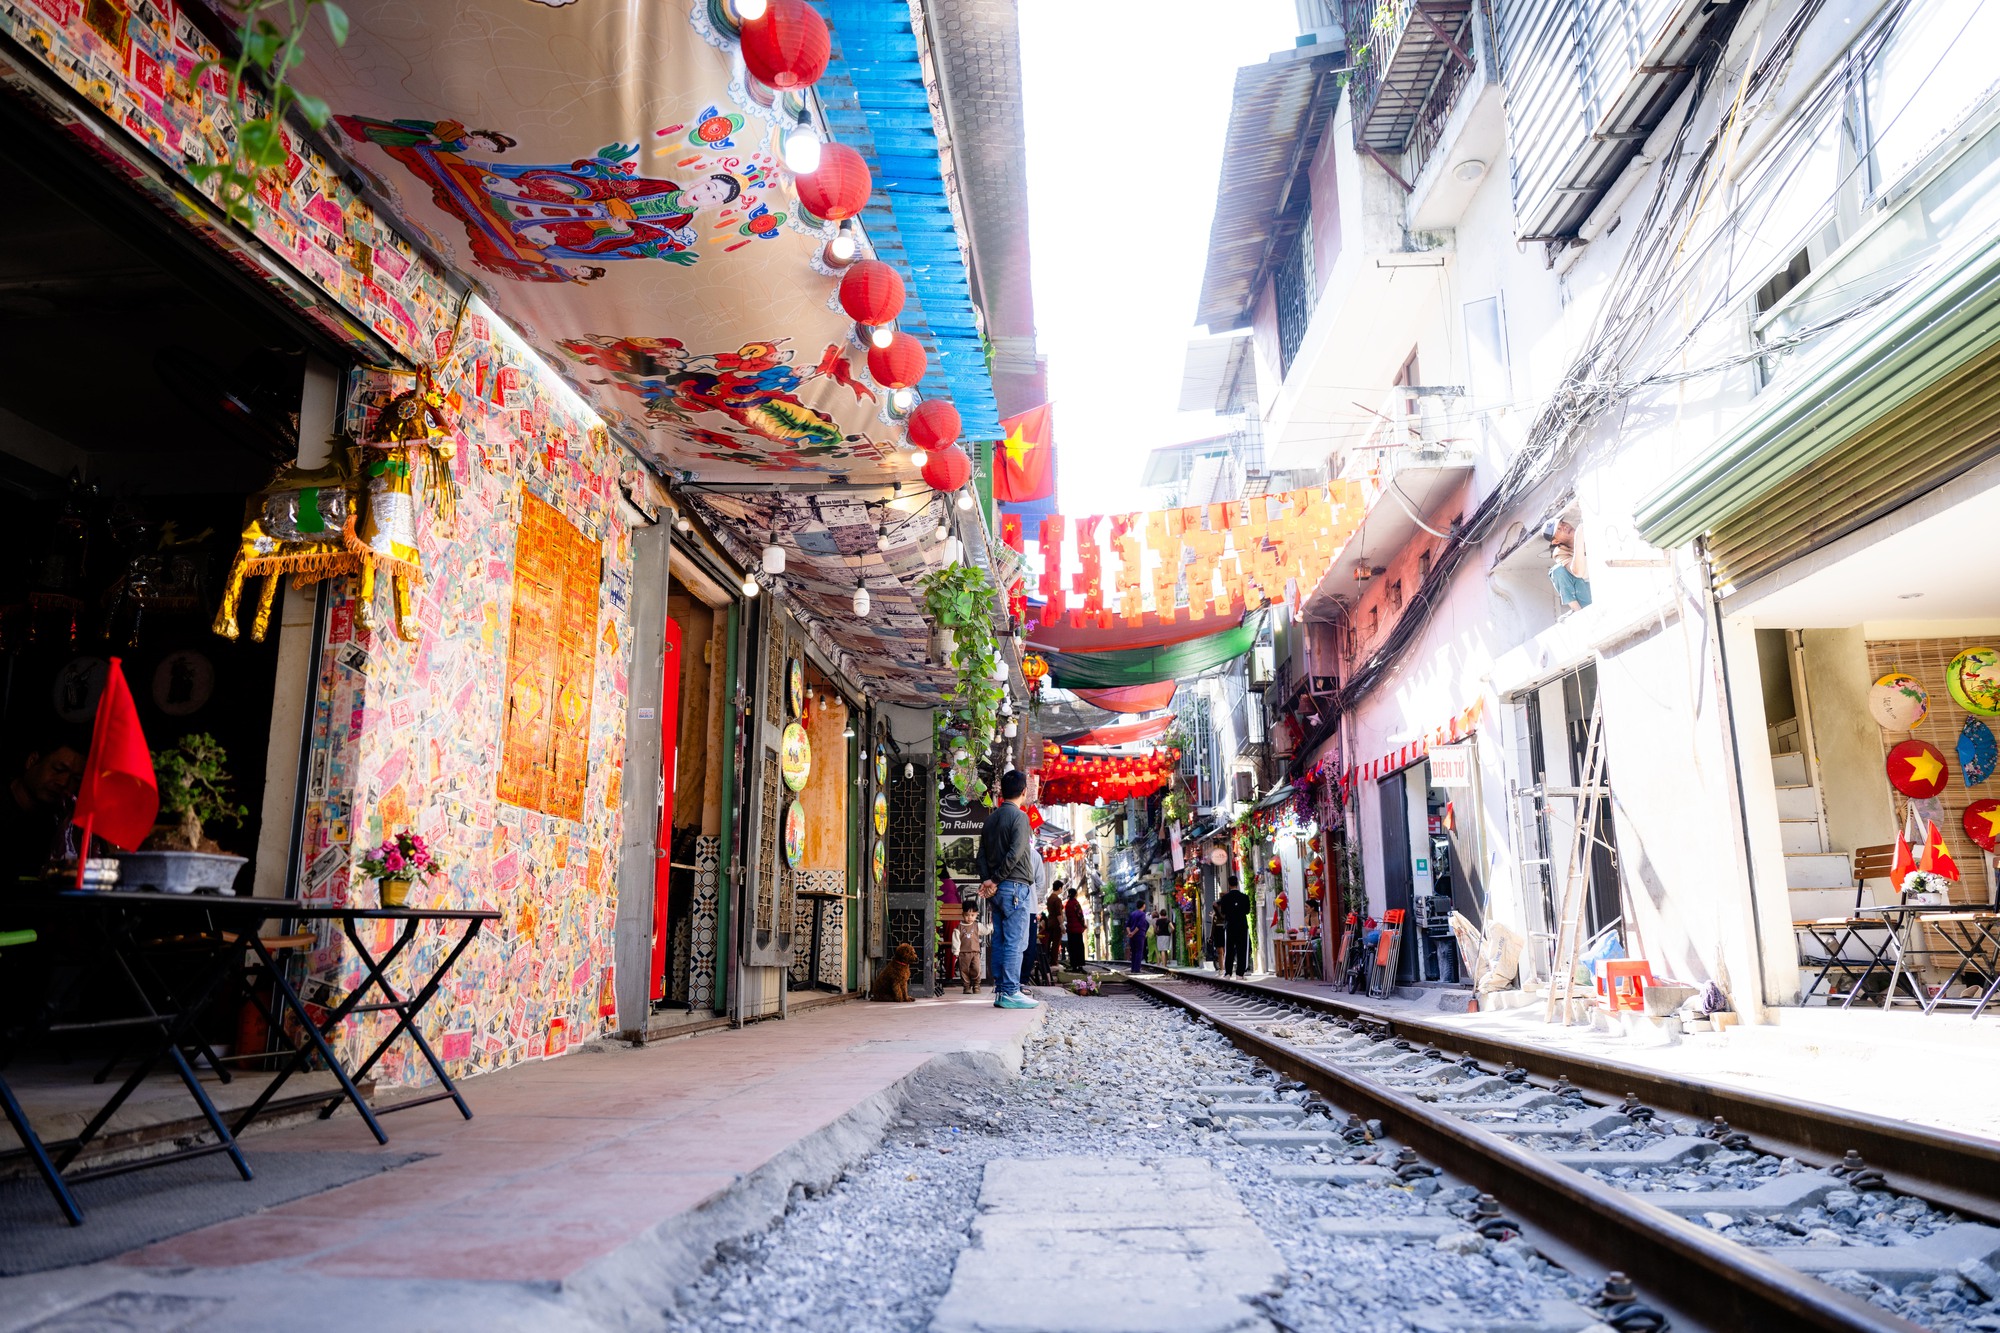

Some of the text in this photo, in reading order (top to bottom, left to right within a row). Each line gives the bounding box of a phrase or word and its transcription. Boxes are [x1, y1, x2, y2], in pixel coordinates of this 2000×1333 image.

[1432, 758, 1453, 782] ĐIỆN
[940, 820, 984, 829] On Railwa
